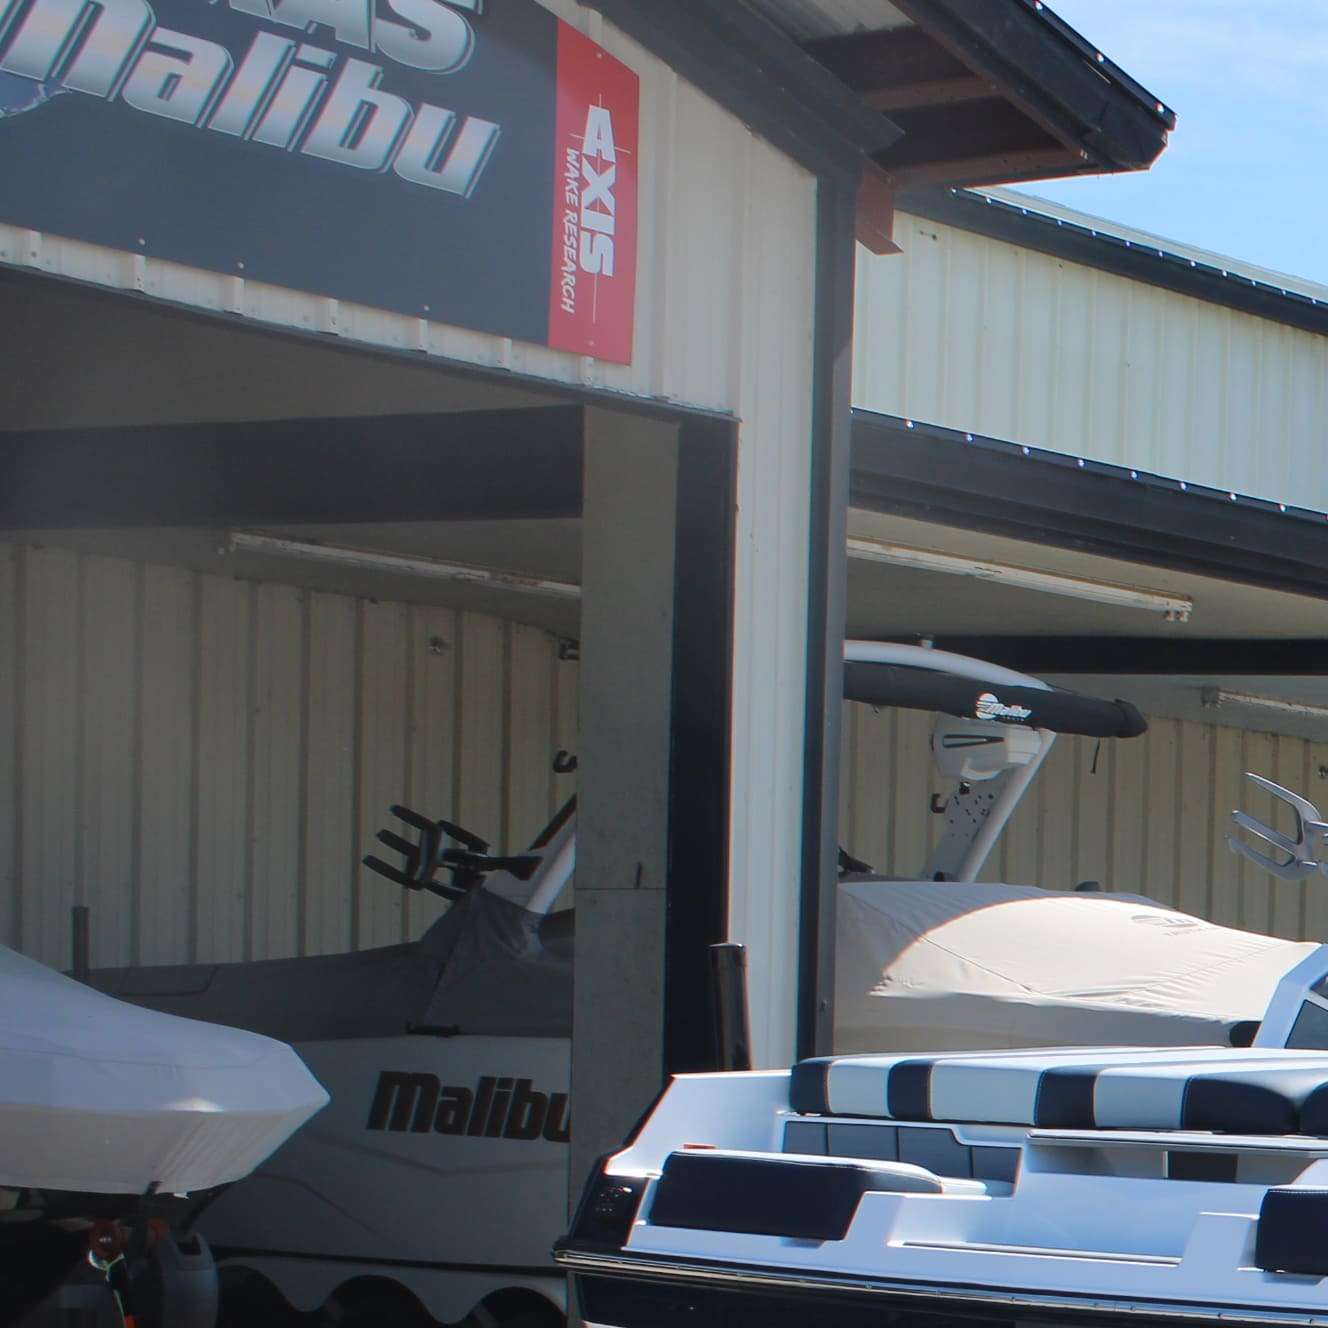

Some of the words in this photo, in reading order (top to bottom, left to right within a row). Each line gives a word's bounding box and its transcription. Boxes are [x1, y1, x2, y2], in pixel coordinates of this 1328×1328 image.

[565, 147, 580, 207] WAKE
[579, 104, 616, 277] AXIS
[561, 208, 578, 314] RESEARCH
